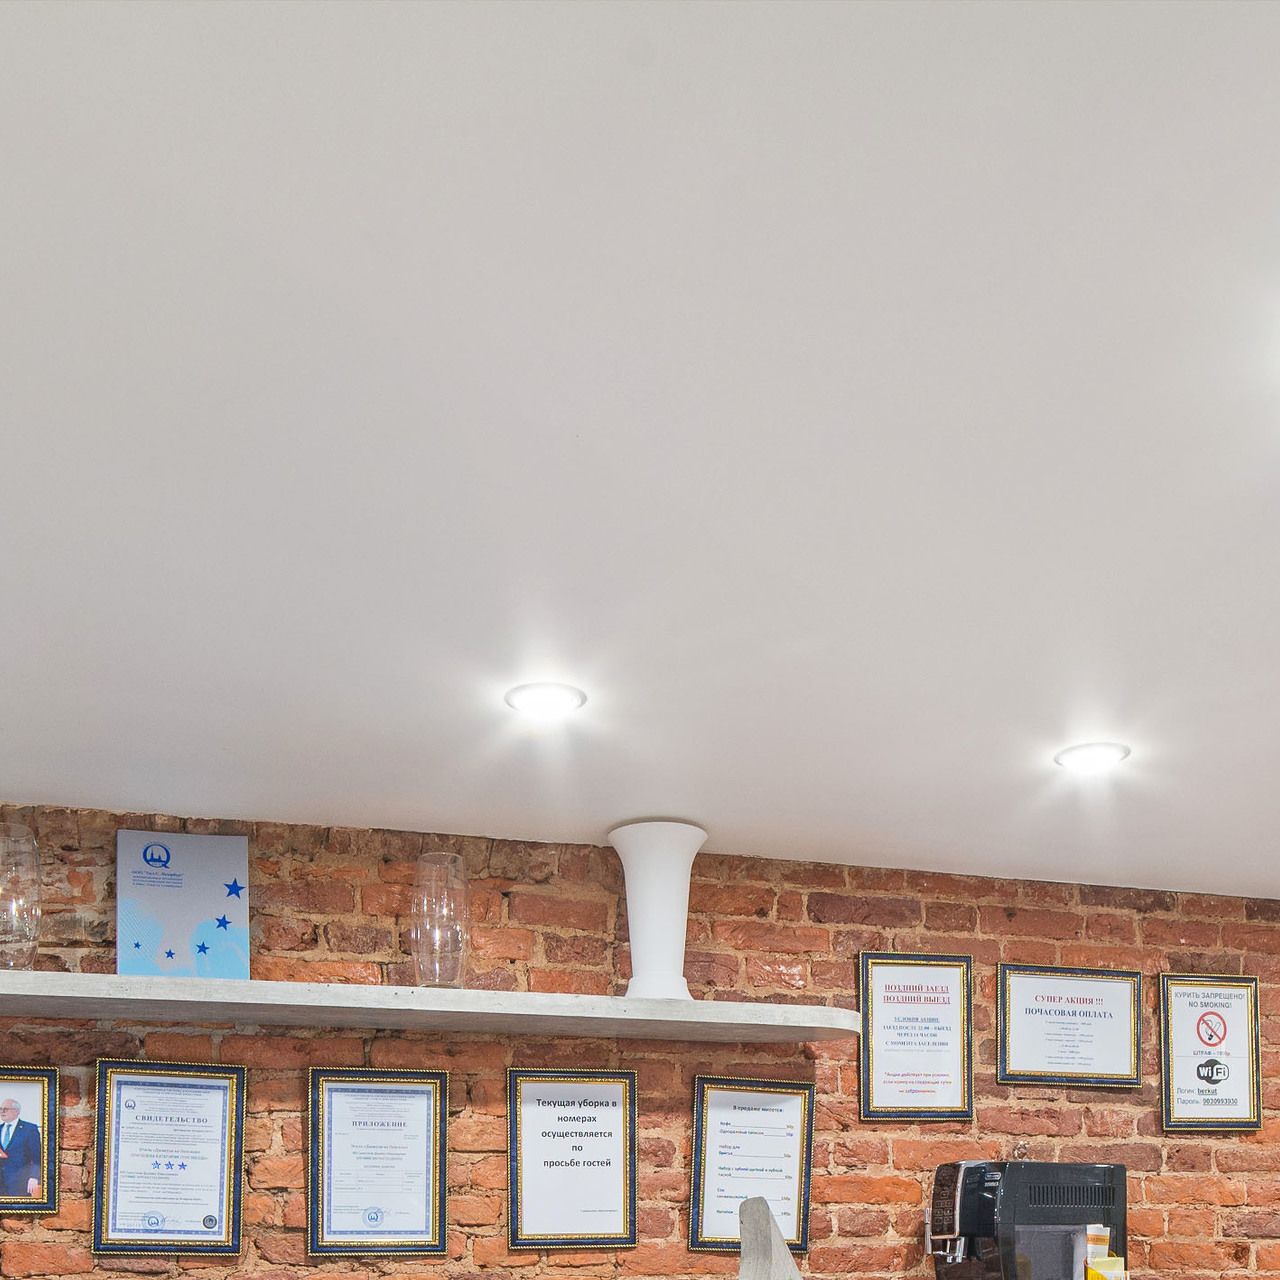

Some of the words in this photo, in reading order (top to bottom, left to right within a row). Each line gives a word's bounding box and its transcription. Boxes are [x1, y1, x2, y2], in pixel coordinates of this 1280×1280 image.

[1034, 994, 1063, 1003] СУПЕР
[1064, 996, 1093, 1005] АКЦИЯ
[1174, 991, 1200, 999] КУРИТЬ
[1202, 992, 1245, 1000] ЗАПРЕЩЕНО!
[1200, 1001, 1232, 1009] SMOKING!
[1024, 1007, 1077, 1017] ПОЧАСОВАЯ
[1078, 1010, 1113, 1019] ОПЛАТА
[536, 1098, 576, 1110] Текущая
[577, 1099, 610, 1110] уборка
[611, 1100, 618, 1108] в
[135, 1114, 209, 1125] СВИДЕТЕЛЬСТВО
[351, 1120, 408, 1129] ПРИЛОЖЕНИЕ
[557, 1114, 598, 1124] номерах
[541, 1129, 613, 1140] осуществляется
[571, 1143, 584, 1153] по
[543, 1158, 580, 1169] просьбе
[582, 1157, 612, 1168] гостей
